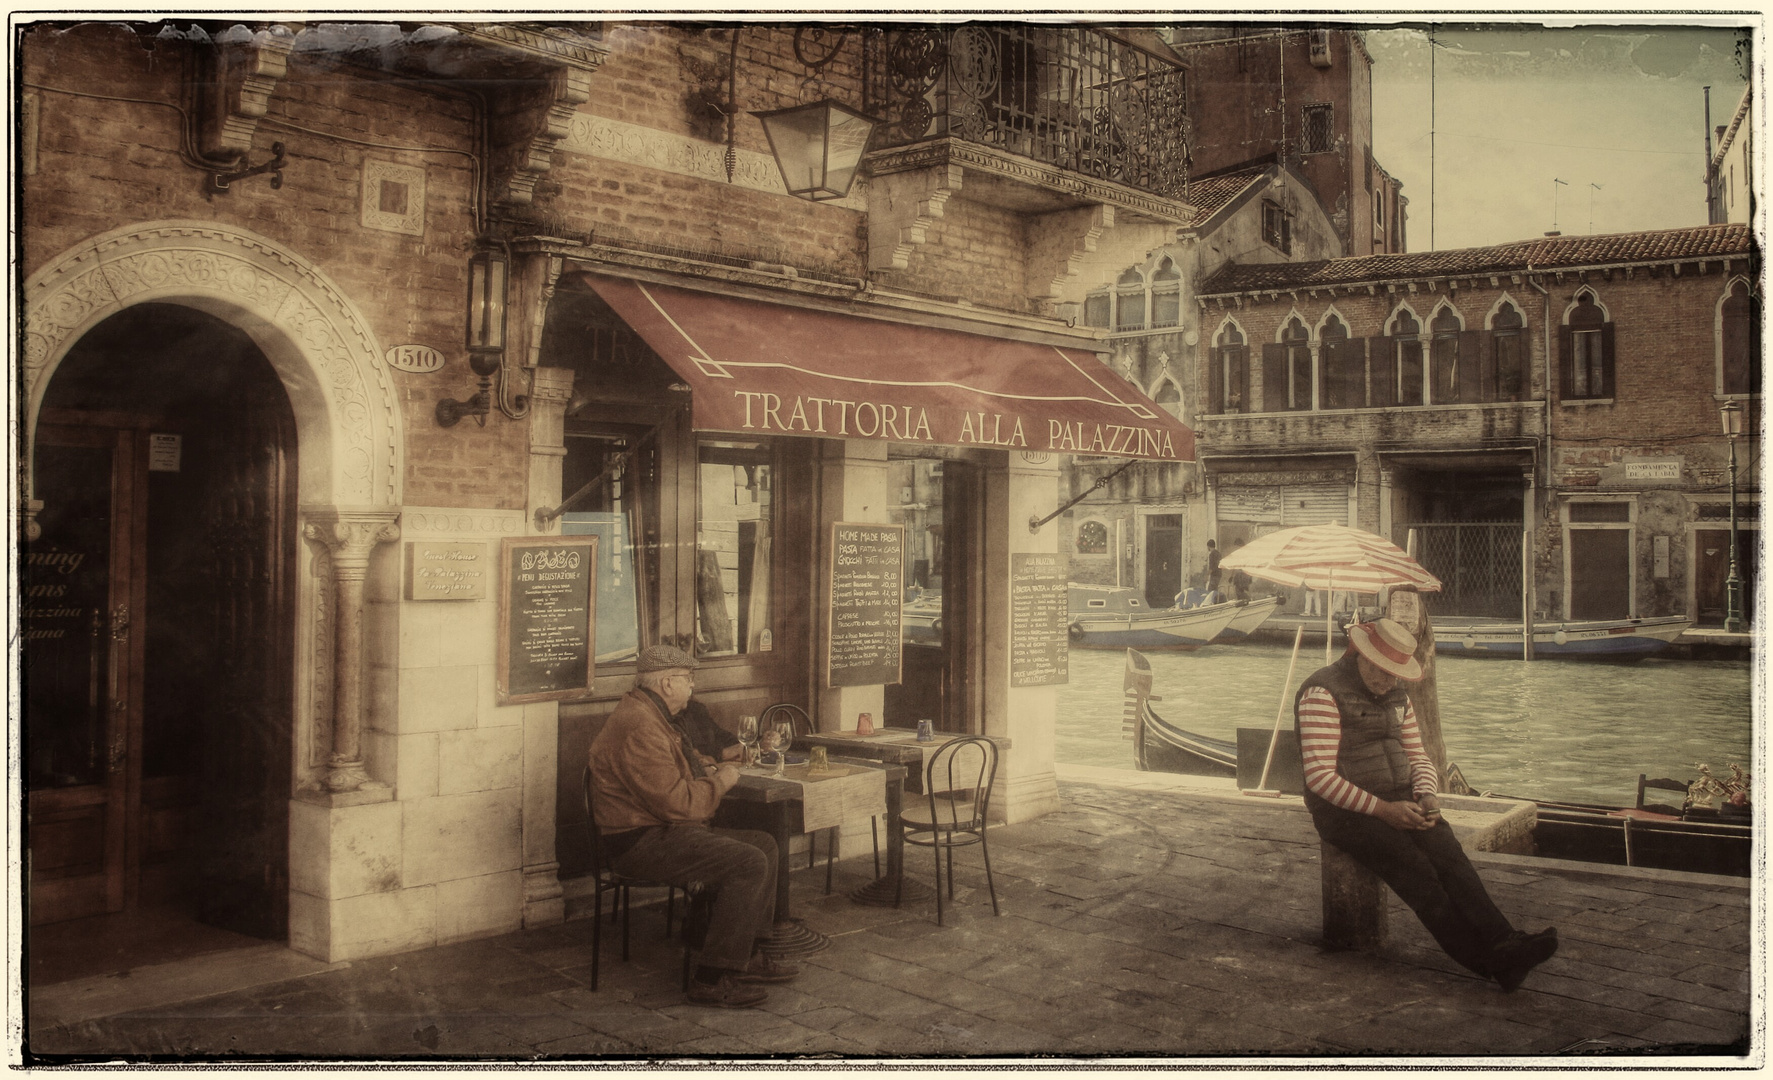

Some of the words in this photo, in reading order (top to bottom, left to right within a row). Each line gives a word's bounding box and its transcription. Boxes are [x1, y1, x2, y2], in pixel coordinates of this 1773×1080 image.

[394, 347, 437, 368] 1510
[733, 389, 934, 441] TRATTORIA
[957, 410, 1027, 448] ALLA
[1048, 418, 1177, 458] PALAZZINA
[840, 530, 858, 541] HOME
[860, 532, 878, 542] MADE
[881, 532, 897, 542] PASTA
[839, 543, 858, 554] PASTA
